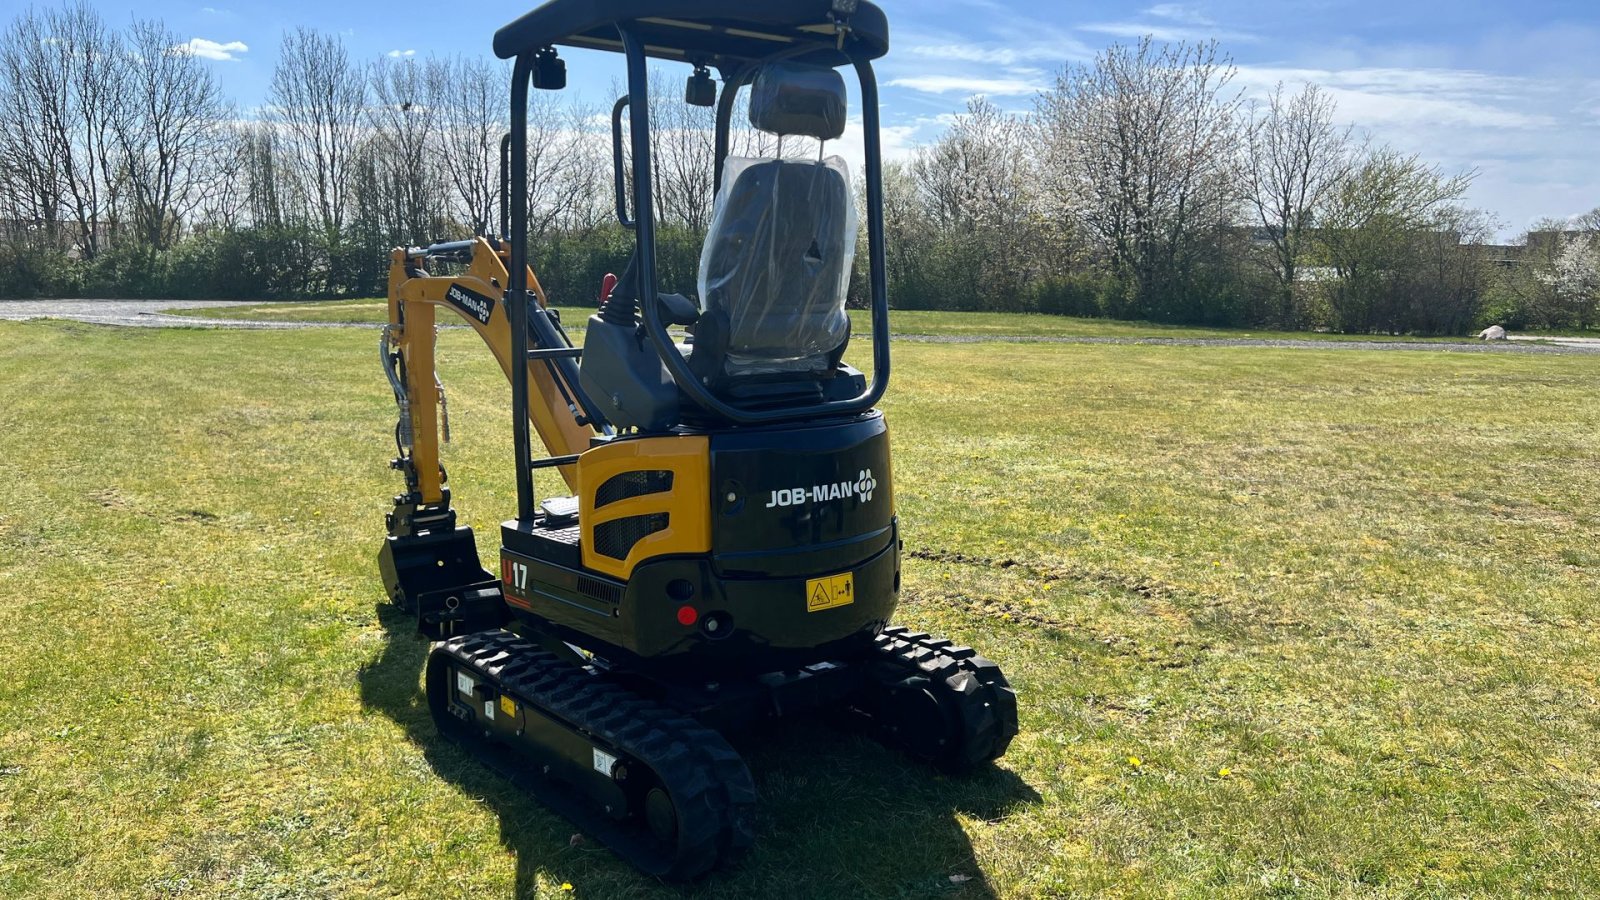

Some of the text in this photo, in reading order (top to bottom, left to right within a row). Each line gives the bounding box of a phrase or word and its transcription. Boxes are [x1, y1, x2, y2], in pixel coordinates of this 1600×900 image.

[450, 287, 477, 311] JOB-MAN
[766, 481, 852, 508] JOB-MAN
[502, 559, 527, 589] U17
